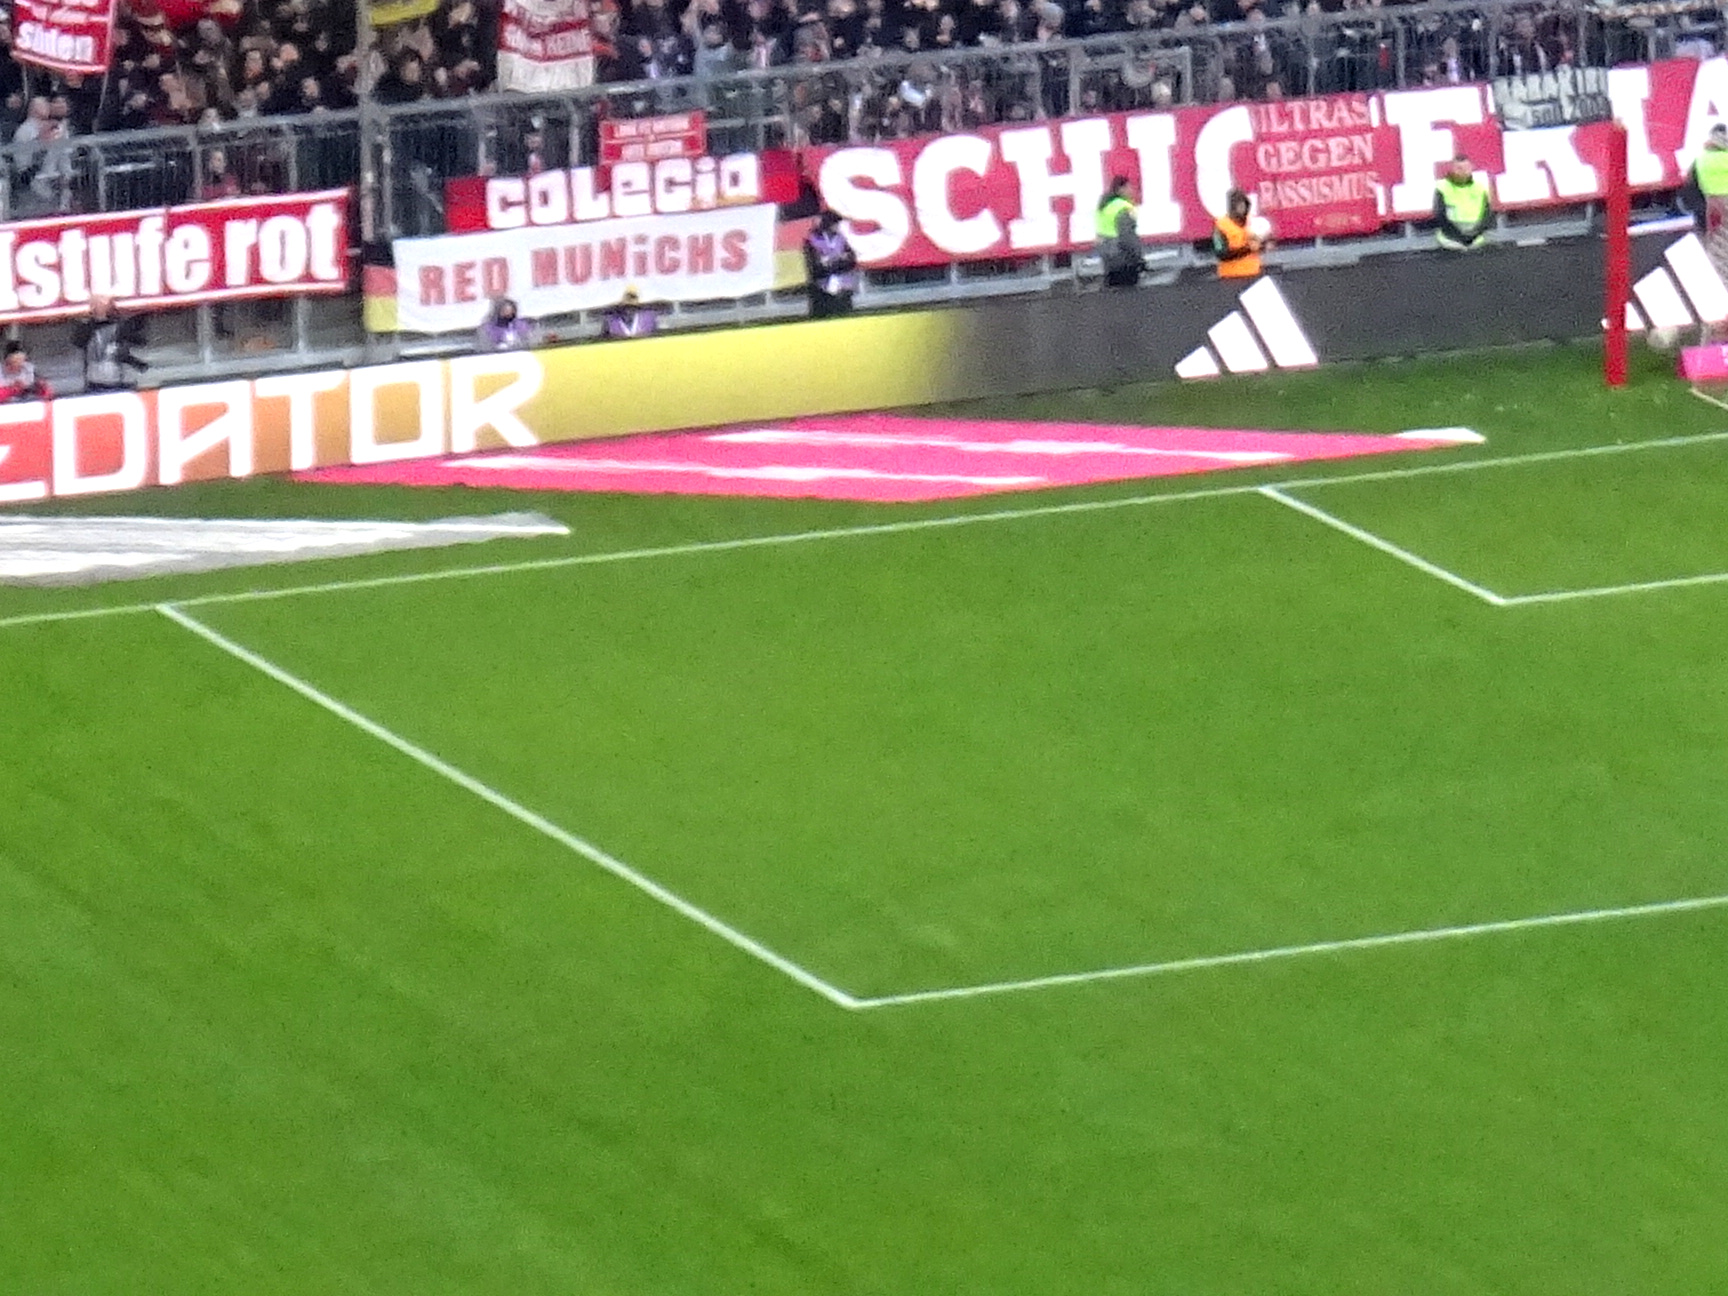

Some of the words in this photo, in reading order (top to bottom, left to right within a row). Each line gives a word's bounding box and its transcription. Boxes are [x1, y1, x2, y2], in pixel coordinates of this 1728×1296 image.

[1255, 132, 1374, 173] GEGEN
[224, 205, 344, 286] rot
[418, 257, 510, 306] RED
